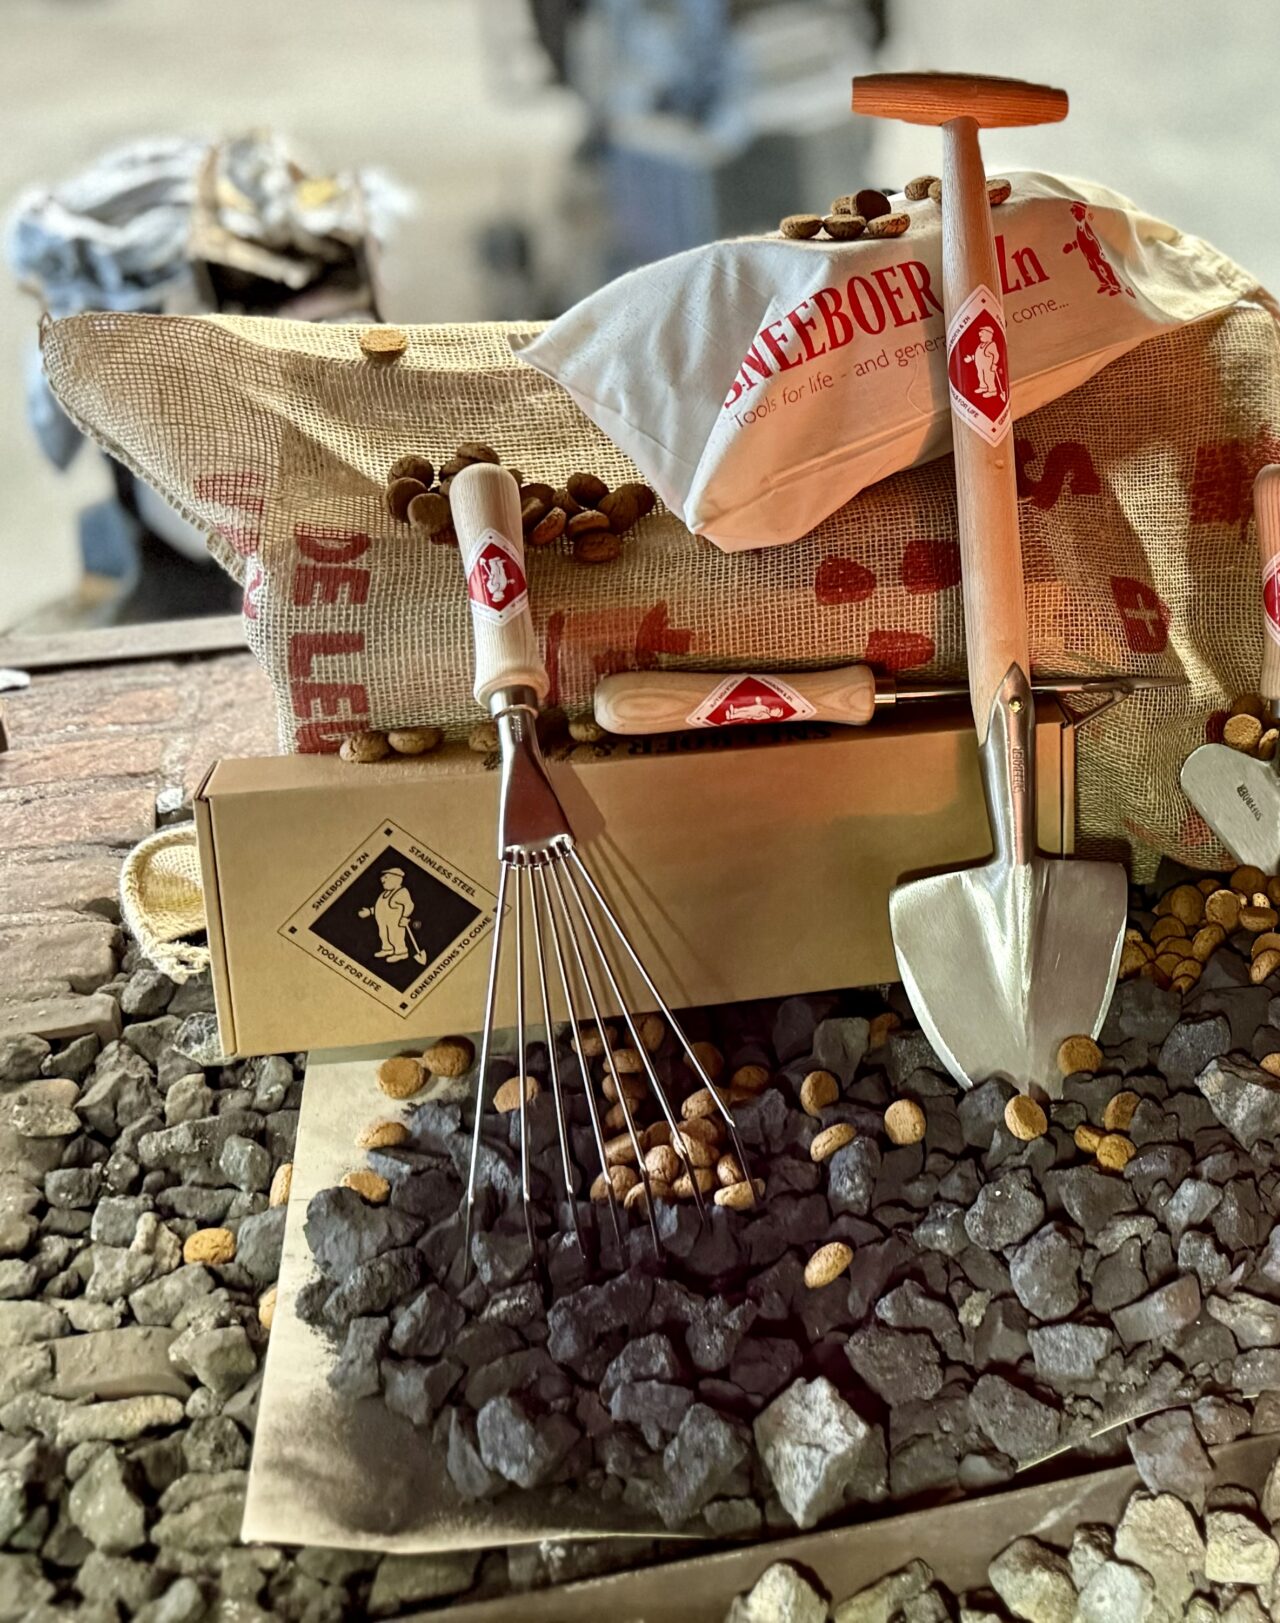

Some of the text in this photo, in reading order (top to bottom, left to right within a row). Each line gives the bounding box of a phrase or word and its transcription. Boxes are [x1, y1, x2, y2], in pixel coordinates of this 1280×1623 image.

[730, 398, 777, 428] Tools
[782, 385, 805, 405] for
[808, 372, 834, 394] life
[853, 349, 890, 377] and
[294, 522, 371, 606] DE
[312, 870, 351, 911] SNEEBOER
[356, 852, 370, 865] ZN
[408, 846, 477, 897] STAINLESS STEEL
[317, 945, 382, 992] TOOLS FOR LIFE
[410, 916, 492, 1000] GENERATIONS TO COME
